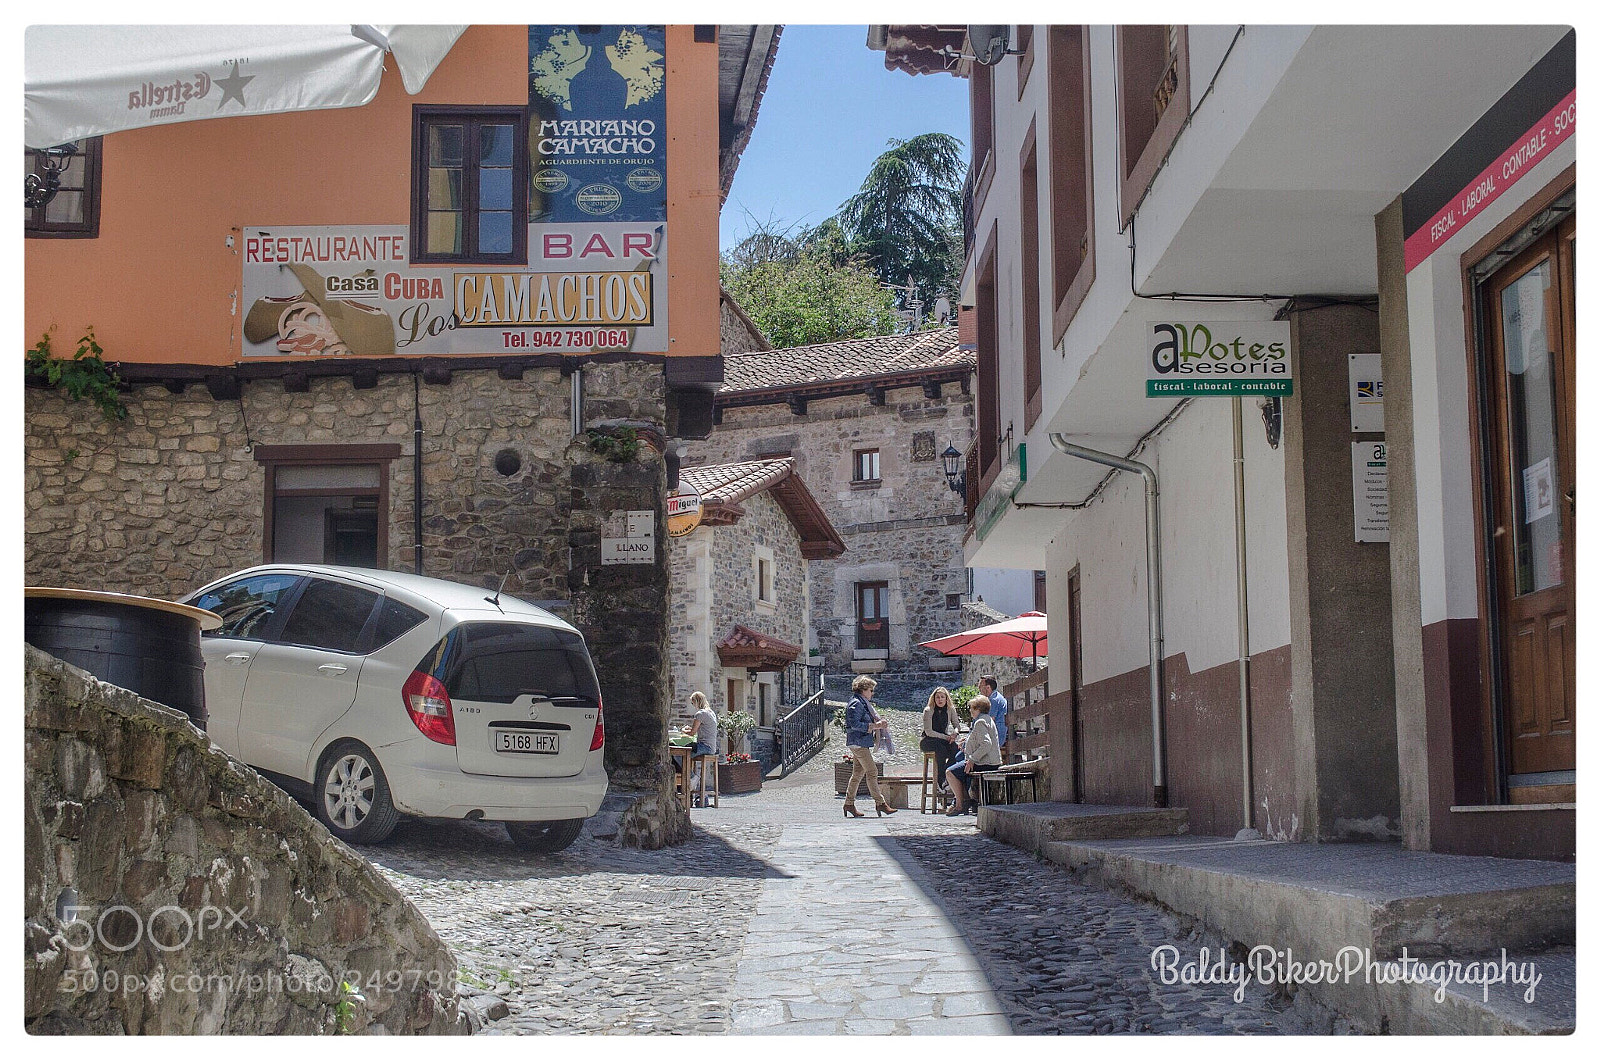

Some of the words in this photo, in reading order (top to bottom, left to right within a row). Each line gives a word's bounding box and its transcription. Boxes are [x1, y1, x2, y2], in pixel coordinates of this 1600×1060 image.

[538, 119, 655, 136] MARIANO
[538, 137, 655, 155] CAMACHO
[539, 158, 606, 166] AGUARDIENTE
[1431, 210, 1456, 243] FISCAL
[1461, 175, 1496, 216] LABORAL
[1502, 128, 1546, 180] CONTABLE
[1554, 99, 1576, 135] SOC
[246, 236, 404, 263] RESTAURANTE
[543, 233, 654, 259] BAR
[326, 275, 379, 291] Casa
[384, 272, 444, 300] CUBA
[396, 302, 470, 348] Los
[457, 273, 648, 323] CAMACHOS
[502, 331, 530, 348] Tel.
[533, 331, 562, 348] 942
[566, 331, 594, 347] 730
[597, 330, 628, 347] 064
[1154, 382, 1185, 391] fiscal
[1193, 382, 1233, 391] laboral
[1241, 382, 1286, 391] contable
[668, 498, 698, 511] Miguel
[503, 734, 531, 750] 5168
[536, 736, 556, 751] HFX
